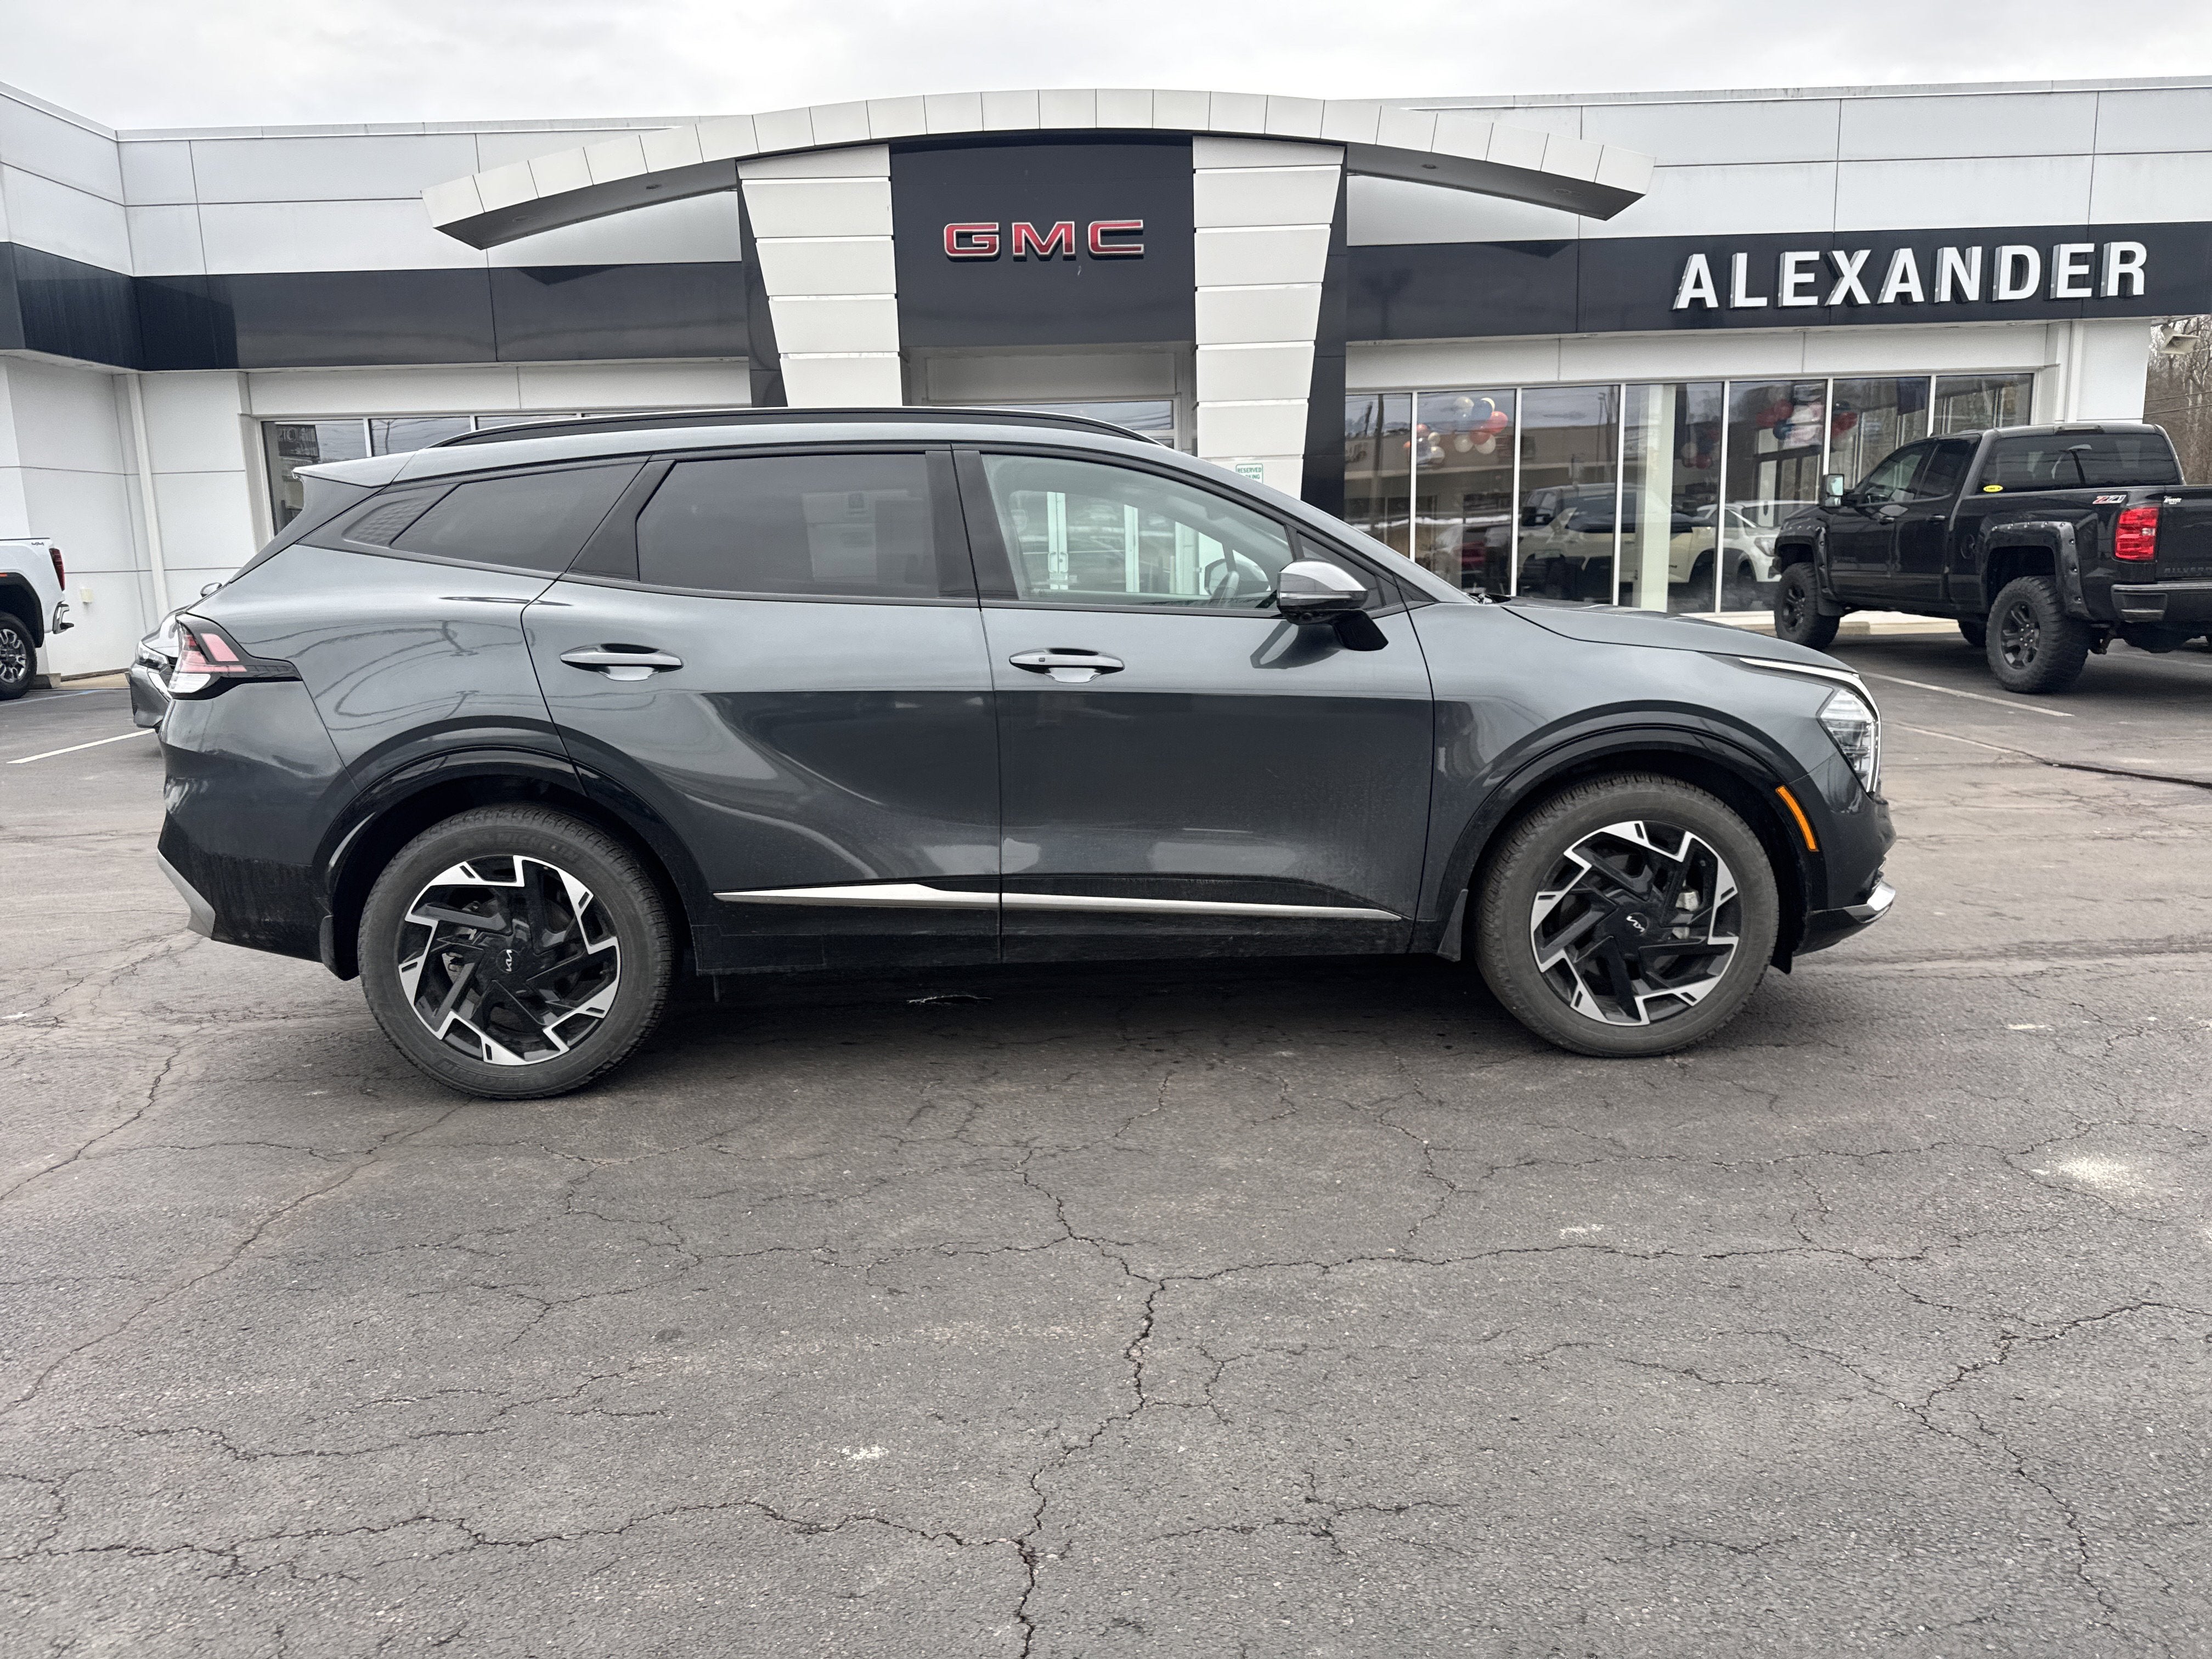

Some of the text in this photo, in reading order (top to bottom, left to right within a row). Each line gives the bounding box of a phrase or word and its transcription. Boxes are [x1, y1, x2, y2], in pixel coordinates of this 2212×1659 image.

[944, 219, 1144, 261] GMC
[1673, 241, 2147, 310] ALEXANDER
[2092, 495, 2127, 504] Z71
